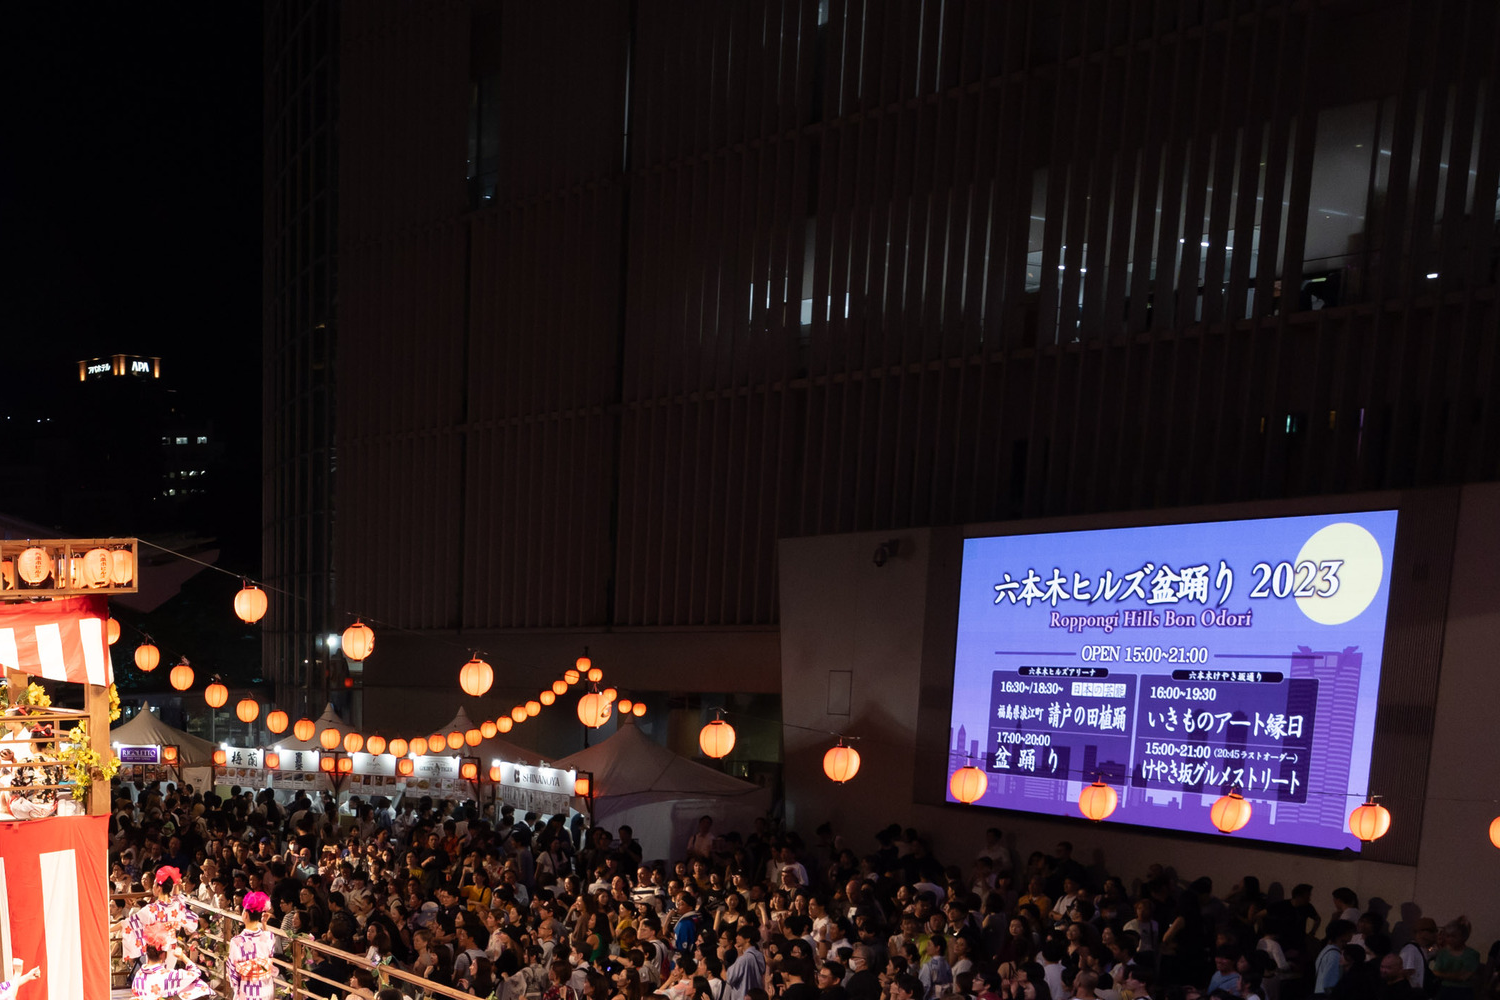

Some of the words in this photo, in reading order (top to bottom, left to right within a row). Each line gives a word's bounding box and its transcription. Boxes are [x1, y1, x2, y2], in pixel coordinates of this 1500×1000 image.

[88, 363, 111, 374] アパホテル
[131, 361, 150, 373] APA
[994, 561, 1233, 606] 六本木ヒルズ盆踊り
[1250, 560, 1344, 599] 2023
[1050, 610, 1119, 633] Roppongi
[1123, 610, 1160, 628] Hills
[1164, 610, 1196, 627] Bon
[1201, 608, 1252, 627] Odori
[1081, 645, 1121, 662] OPEN
[1028, 667, 1096, 677] 六本木ヒルズアリーナ
[1188, 670, 1262, 682] 六本木けやき坂通り
[997, 704, 1044, 721] 福島県浪江町
[1048, 702, 1127, 732] 請戸の田植踊
[1148, 707, 1304, 740] いきものアート縁日
[122, 749, 156, 757] RIGOLETTO
[993, 746, 1058, 773] 盆踊り
[522, 773, 560, 787] SHINANOYA
[1142, 758, 1300, 795] けやき坂グルメストリート
